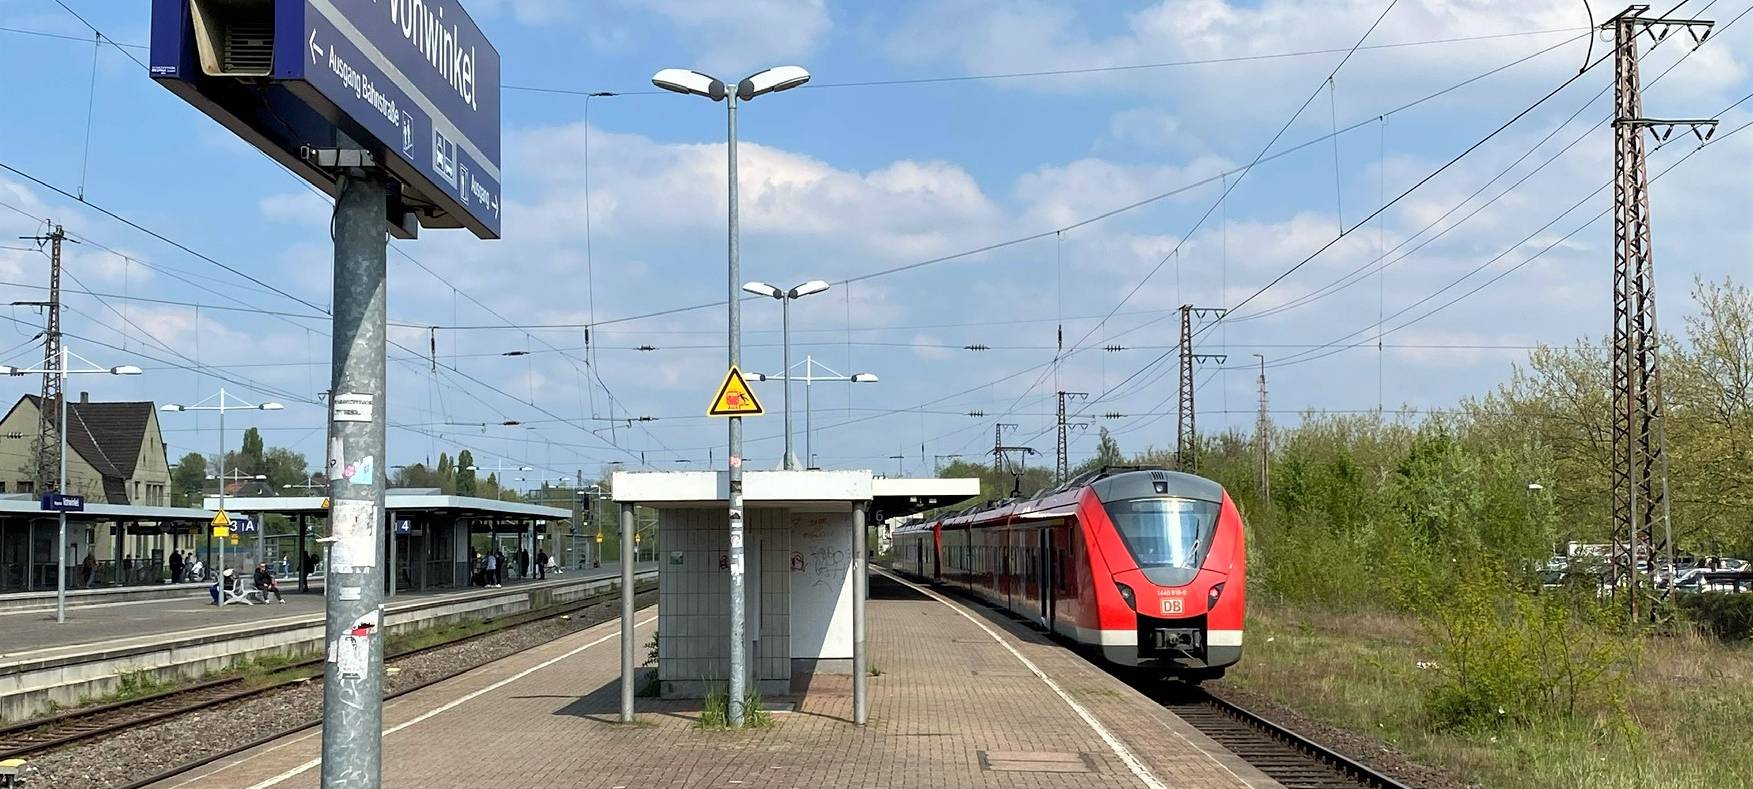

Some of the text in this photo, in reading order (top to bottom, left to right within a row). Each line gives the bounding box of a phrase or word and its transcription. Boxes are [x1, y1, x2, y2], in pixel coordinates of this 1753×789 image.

[328, 45, 400, 127] Ausgang Bahnstraße
[230, 520, 255, 532] 3 A
[401, 520, 410, 532] 4
[1164, 600, 1181, 612] DB
